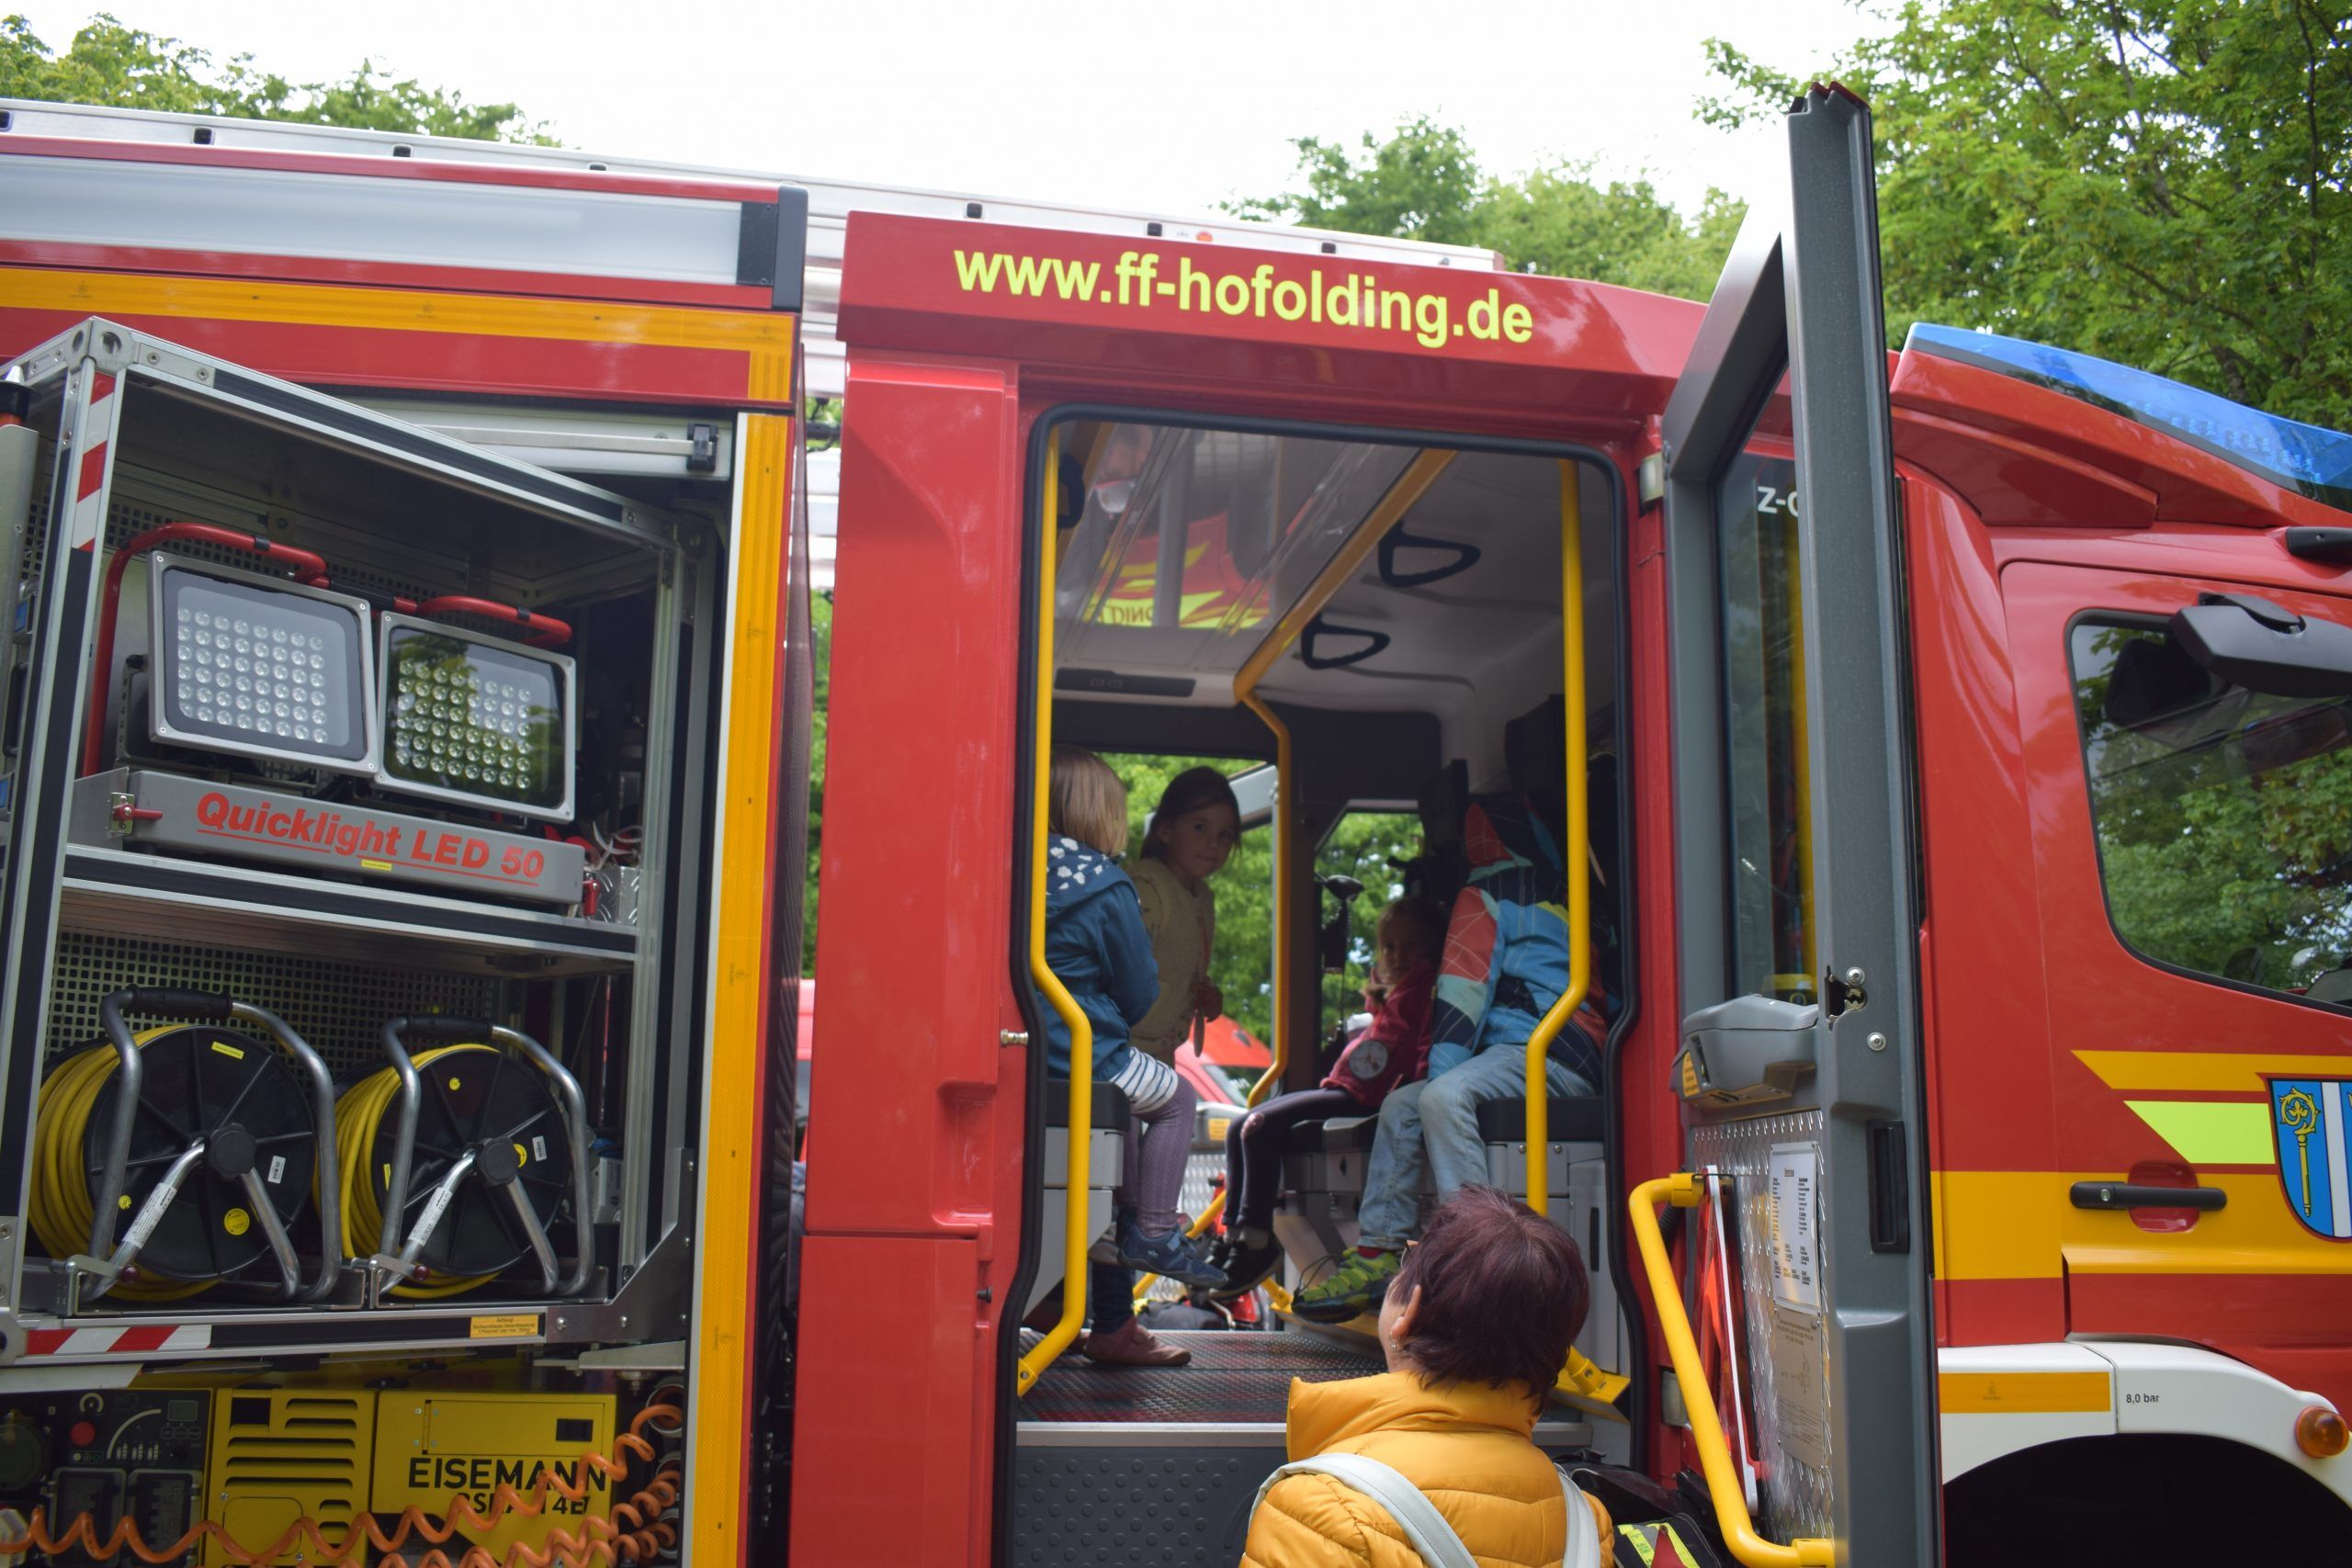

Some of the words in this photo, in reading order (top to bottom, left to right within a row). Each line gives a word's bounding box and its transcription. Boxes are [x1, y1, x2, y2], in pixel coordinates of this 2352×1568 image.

[954, 250, 1533, 348] www.ff-hofolding.de
[197, 792, 401, 856] Quicklight
[411, 829, 490, 870] LED
[500, 846, 545, 879] 50
[2126, 1393, 2141, 1404] 8,0
[2143, 1393, 2160, 1403] bar
[408, 1457, 605, 1492] EISEMANN
